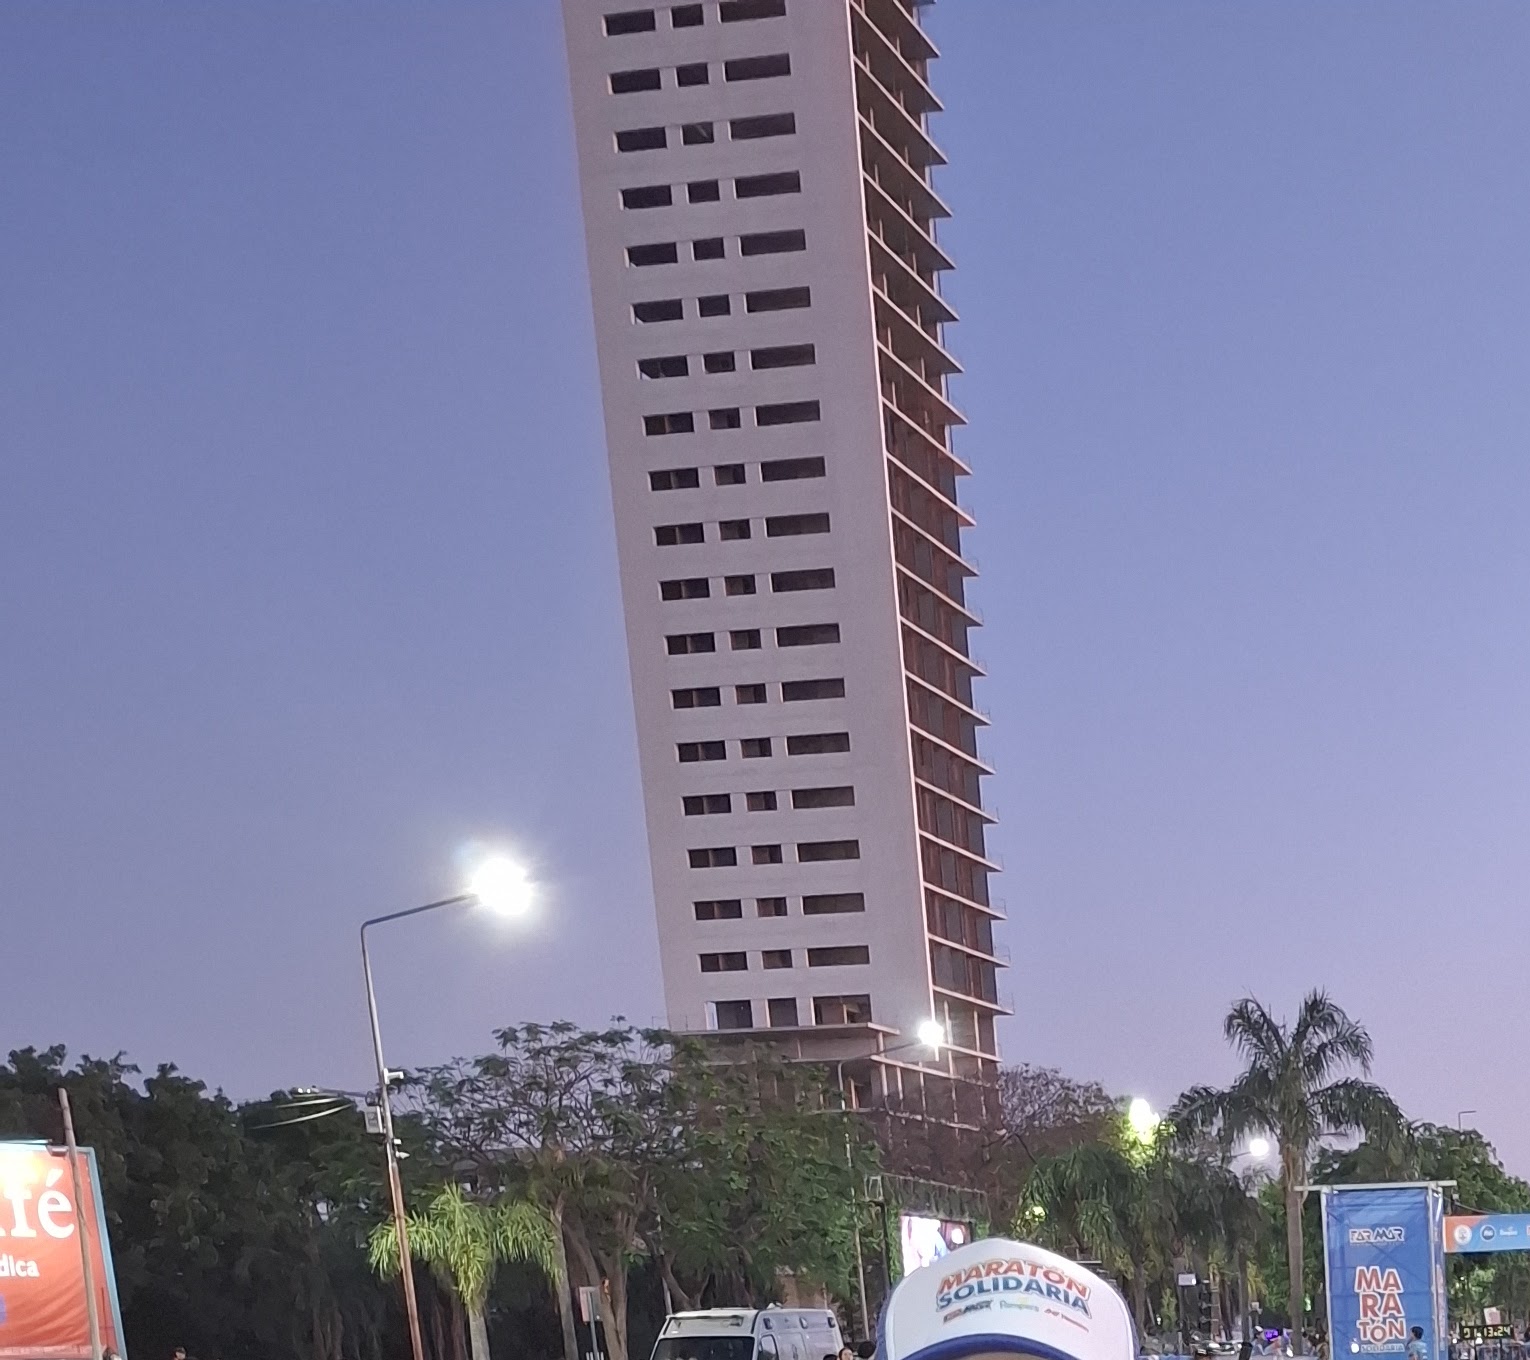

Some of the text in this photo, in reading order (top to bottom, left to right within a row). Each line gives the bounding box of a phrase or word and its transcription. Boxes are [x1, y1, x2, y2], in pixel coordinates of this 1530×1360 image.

[1355, 1265, 1405, 1293] MA
[937, 1276, 1092, 1318] SOLIDARIA
[1359, 1291, 1406, 1319] RA
